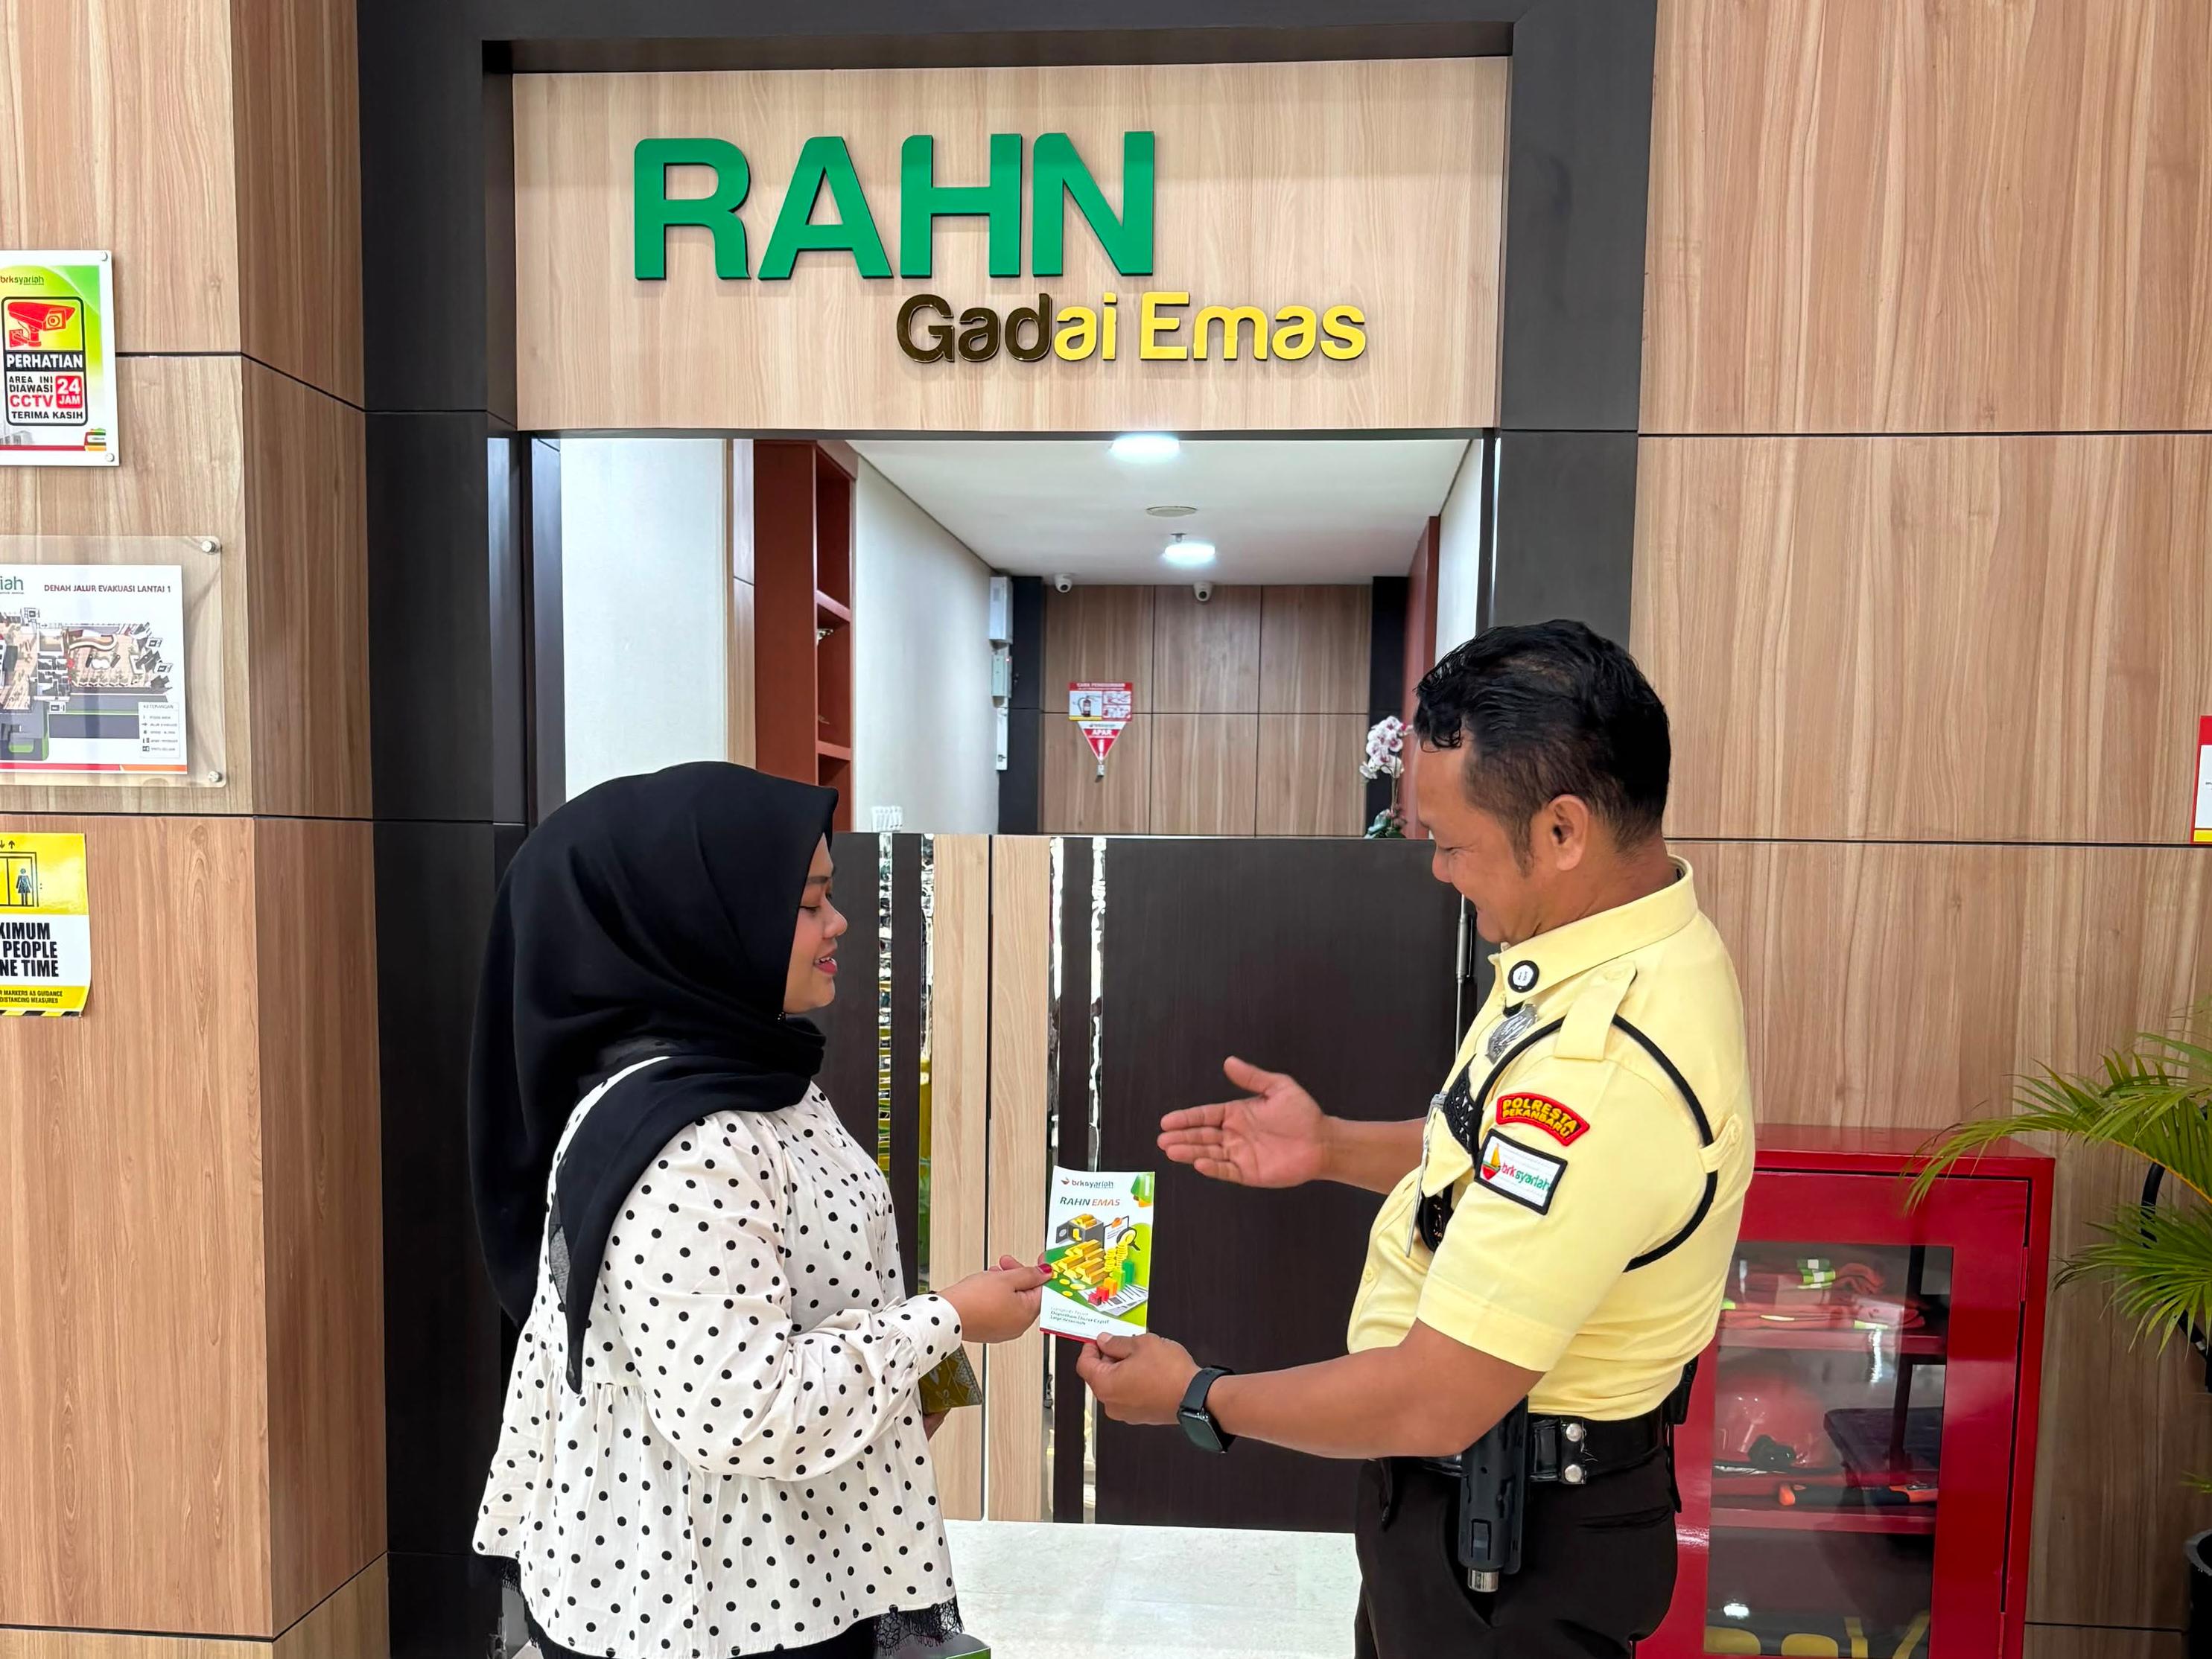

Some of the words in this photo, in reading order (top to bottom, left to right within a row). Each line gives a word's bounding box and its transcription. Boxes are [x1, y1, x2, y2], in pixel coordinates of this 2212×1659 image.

[634, 130, 1156, 281] RAHN
[896, 291, 1118, 363] Gadai
[1140, 291, 1367, 362] Emas
[6, 354, 83, 368] PERHATIAN
[9, 384, 53, 392] DIAWASI
[57, 378, 80, 395] 24
[10, 395, 53, 407] CCTV
[59, 395, 80, 405] JAM
[0, 922, 50, 940] XIMUM
[3, 940, 57, 958] PEOPLE
[0, 959, 18, 976] NE
[21, 960, 59, 977] TIME
[1501, 1098, 1577, 1133] POLRESTA
[1501, 1108, 1570, 1138] PEKANBARU
[1060, 1196, 1090, 1206] RAHN
[1091, 1198, 1120, 1206] EMAS
